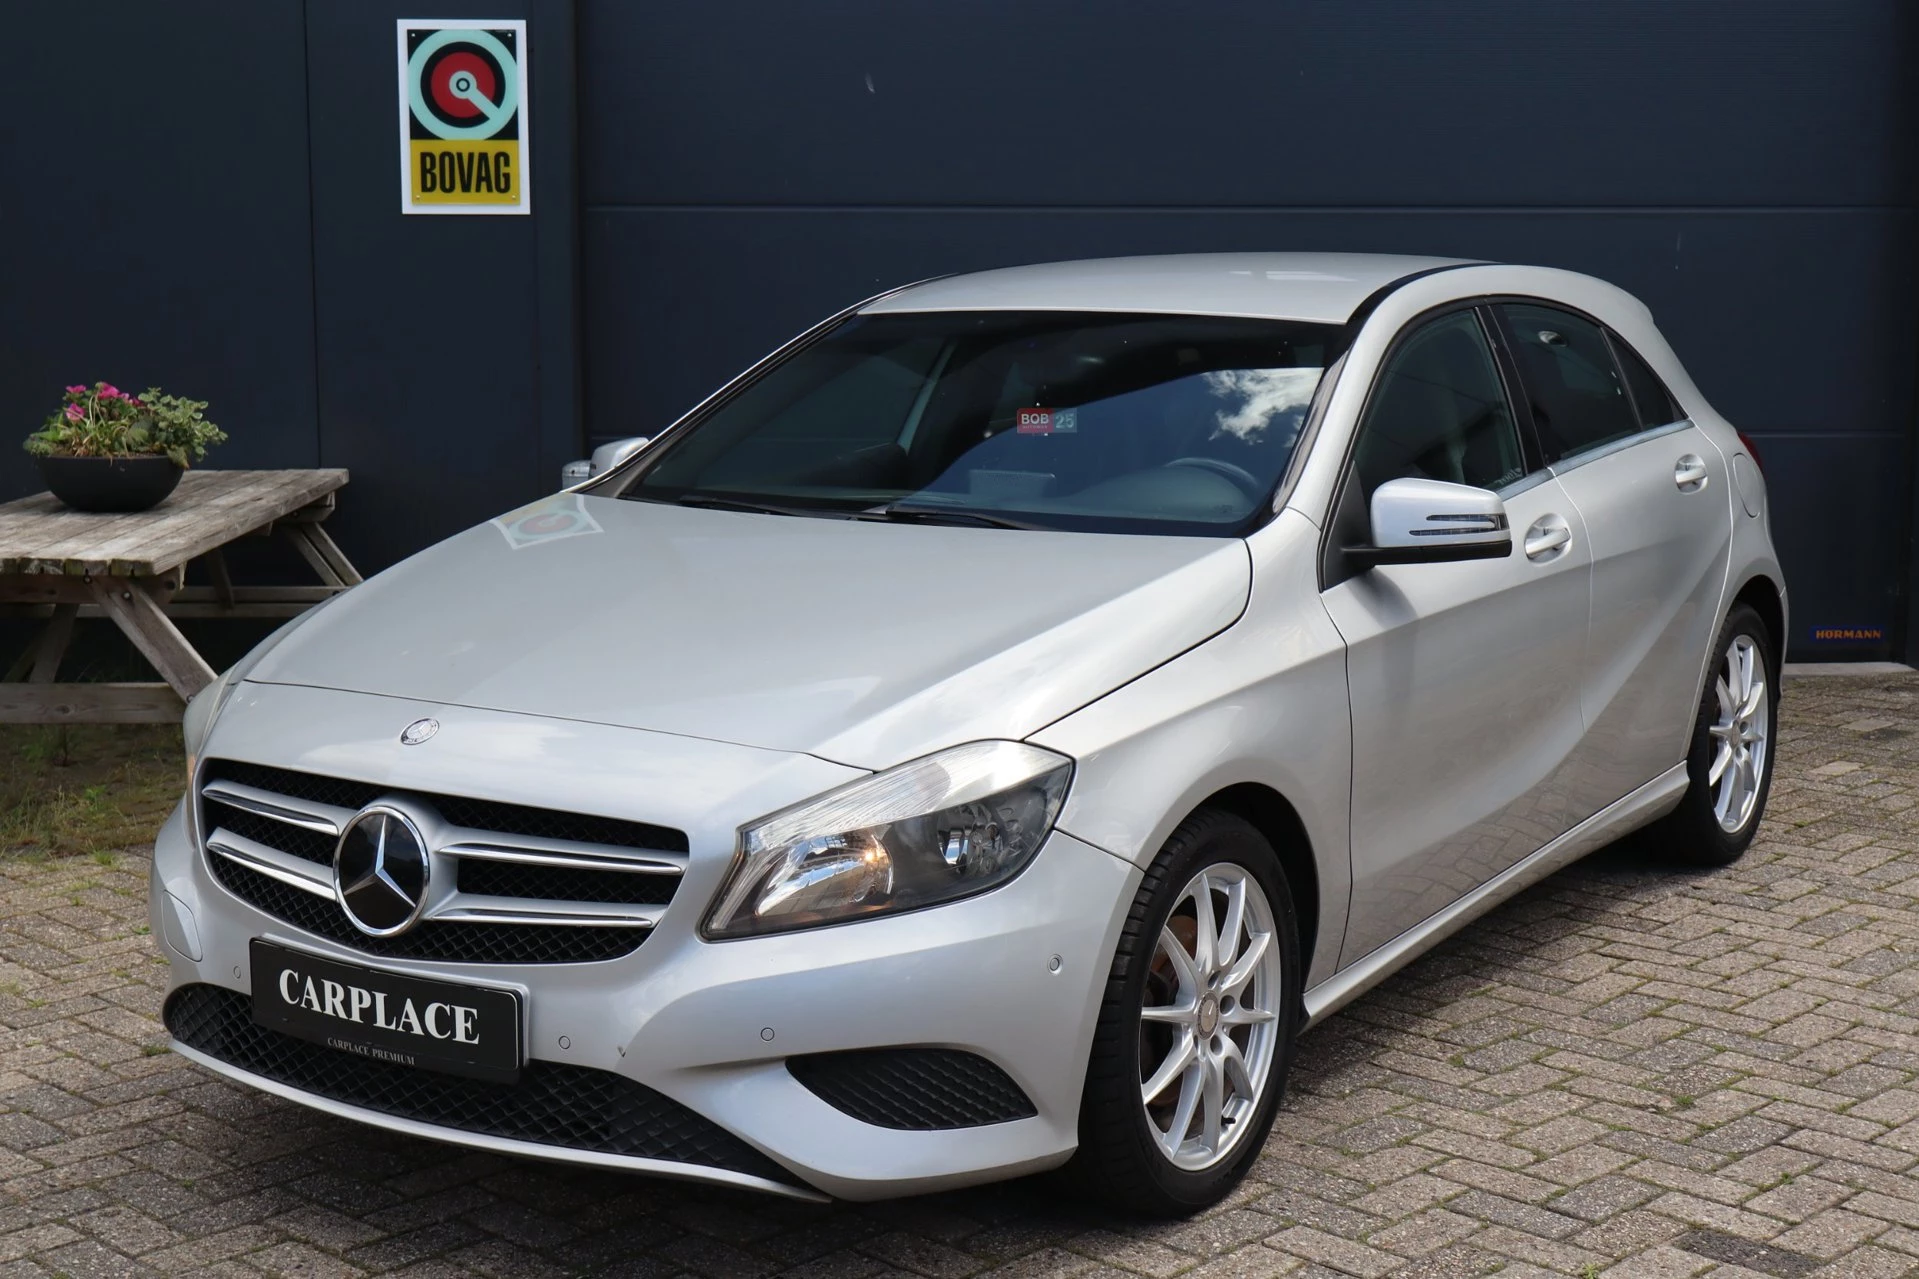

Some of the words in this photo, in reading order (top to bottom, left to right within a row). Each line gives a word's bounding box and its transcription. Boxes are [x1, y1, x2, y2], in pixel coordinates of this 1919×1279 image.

[419, 151, 511, 194] BOVAG
[1021, 413, 1049, 425] BOB
[1055, 412, 1075, 429] 25
[279, 968, 480, 1045] CARPLACE
[327, 1036, 370, 1057] CARPLACE
[372, 1047, 415, 1066] PREMIUM
